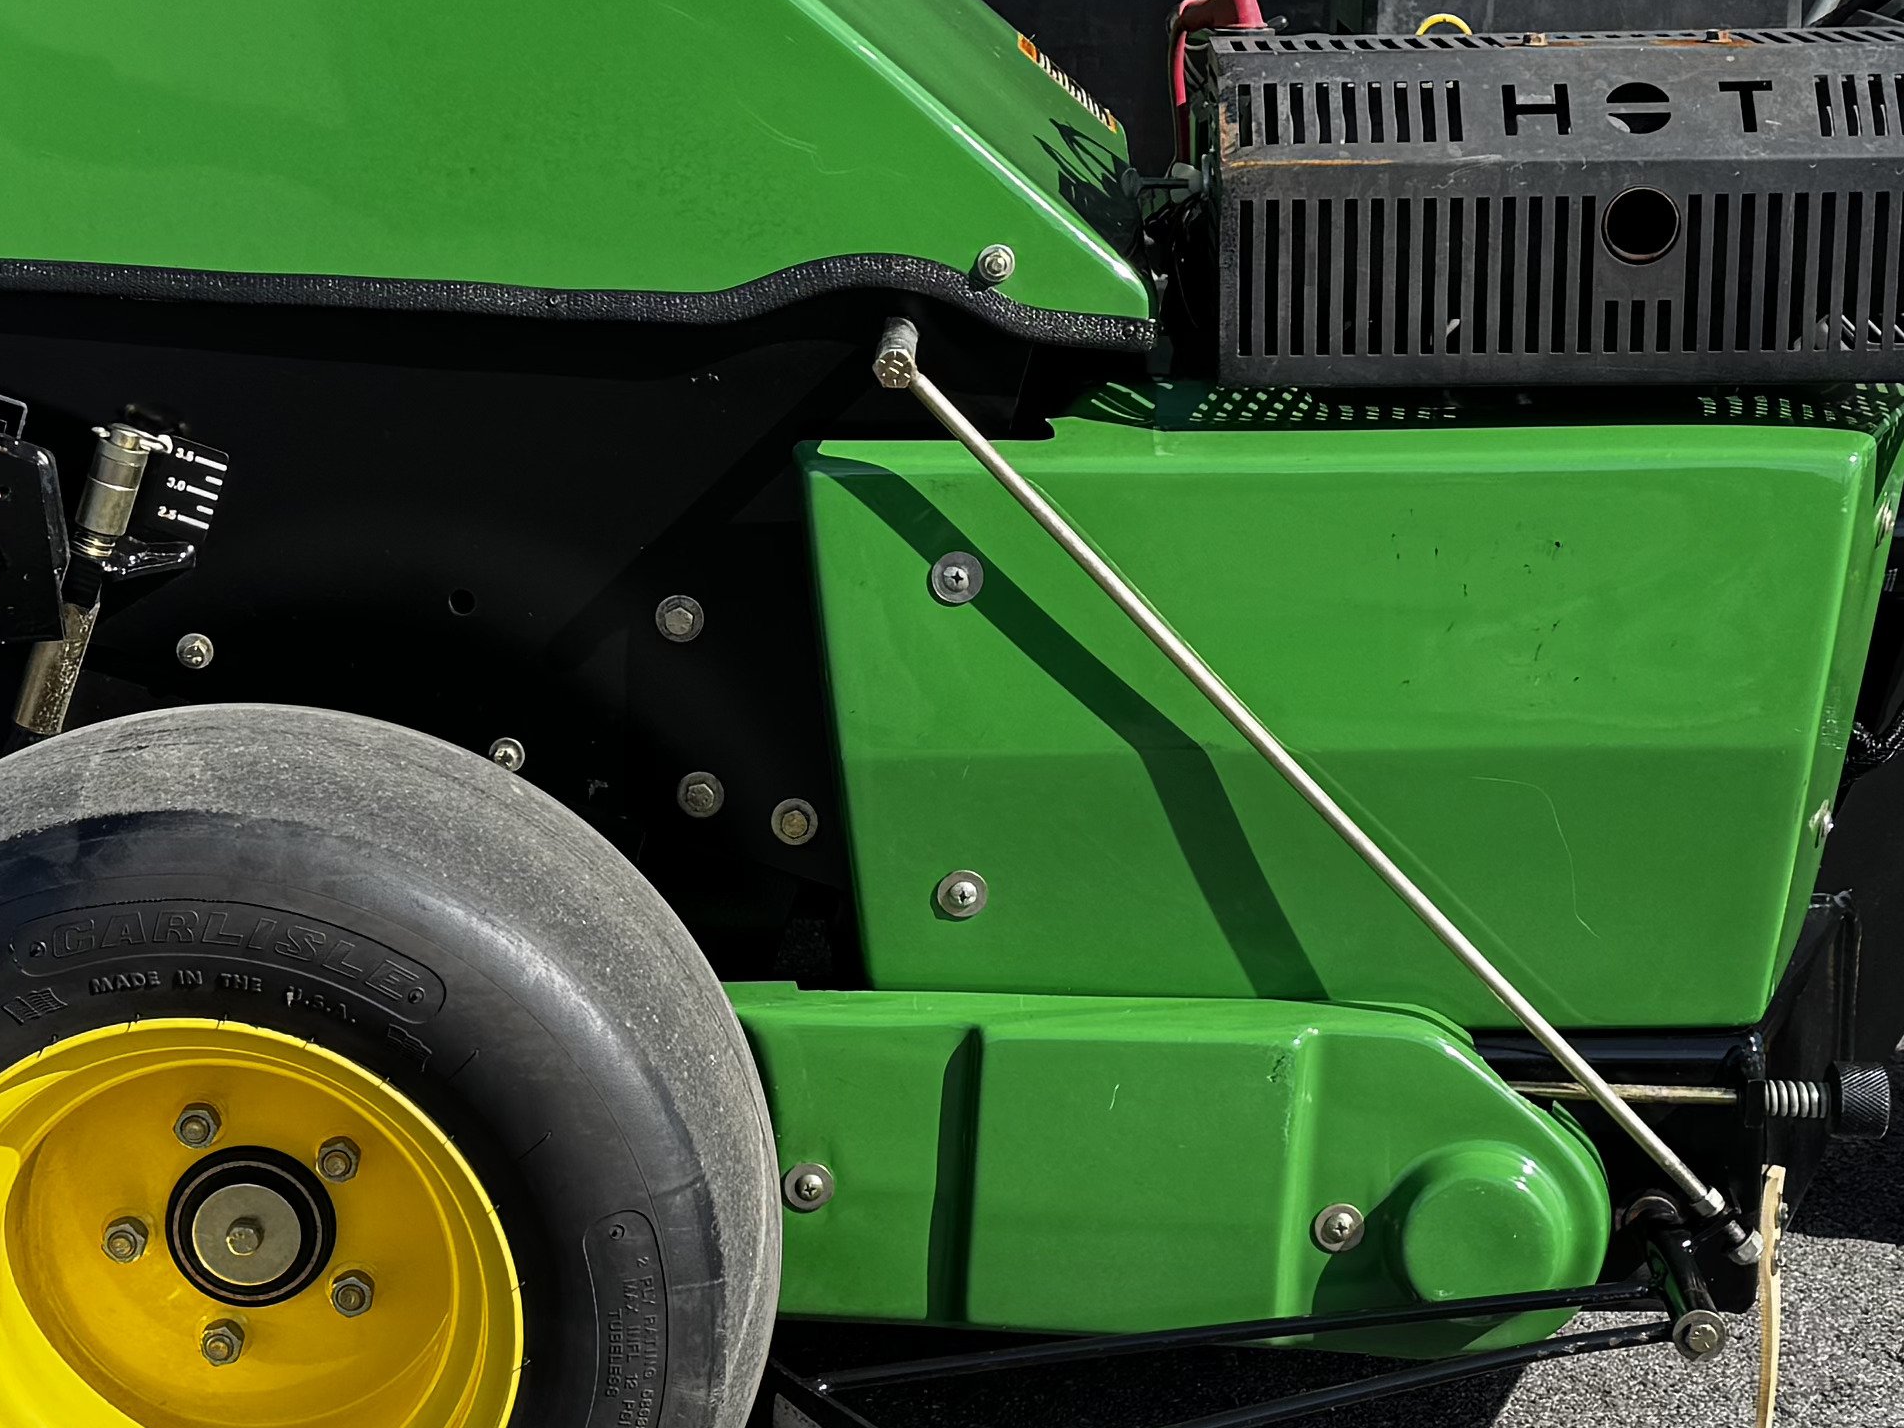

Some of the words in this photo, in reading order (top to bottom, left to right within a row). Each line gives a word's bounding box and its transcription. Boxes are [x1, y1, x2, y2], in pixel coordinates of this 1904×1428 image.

[1501, 79, 1774, 137] HOT
[166, 476, 186, 492] 3.0
[51, 910, 423, 1004] CARLISLE
[89, 968, 163, 996] MADE
[175, 967, 205, 990] IN
[221, 972, 264, 995] THE
[284, 983, 358, 1027] U.S.A.
[605, 1307, 624, 1398] TUBELESS
